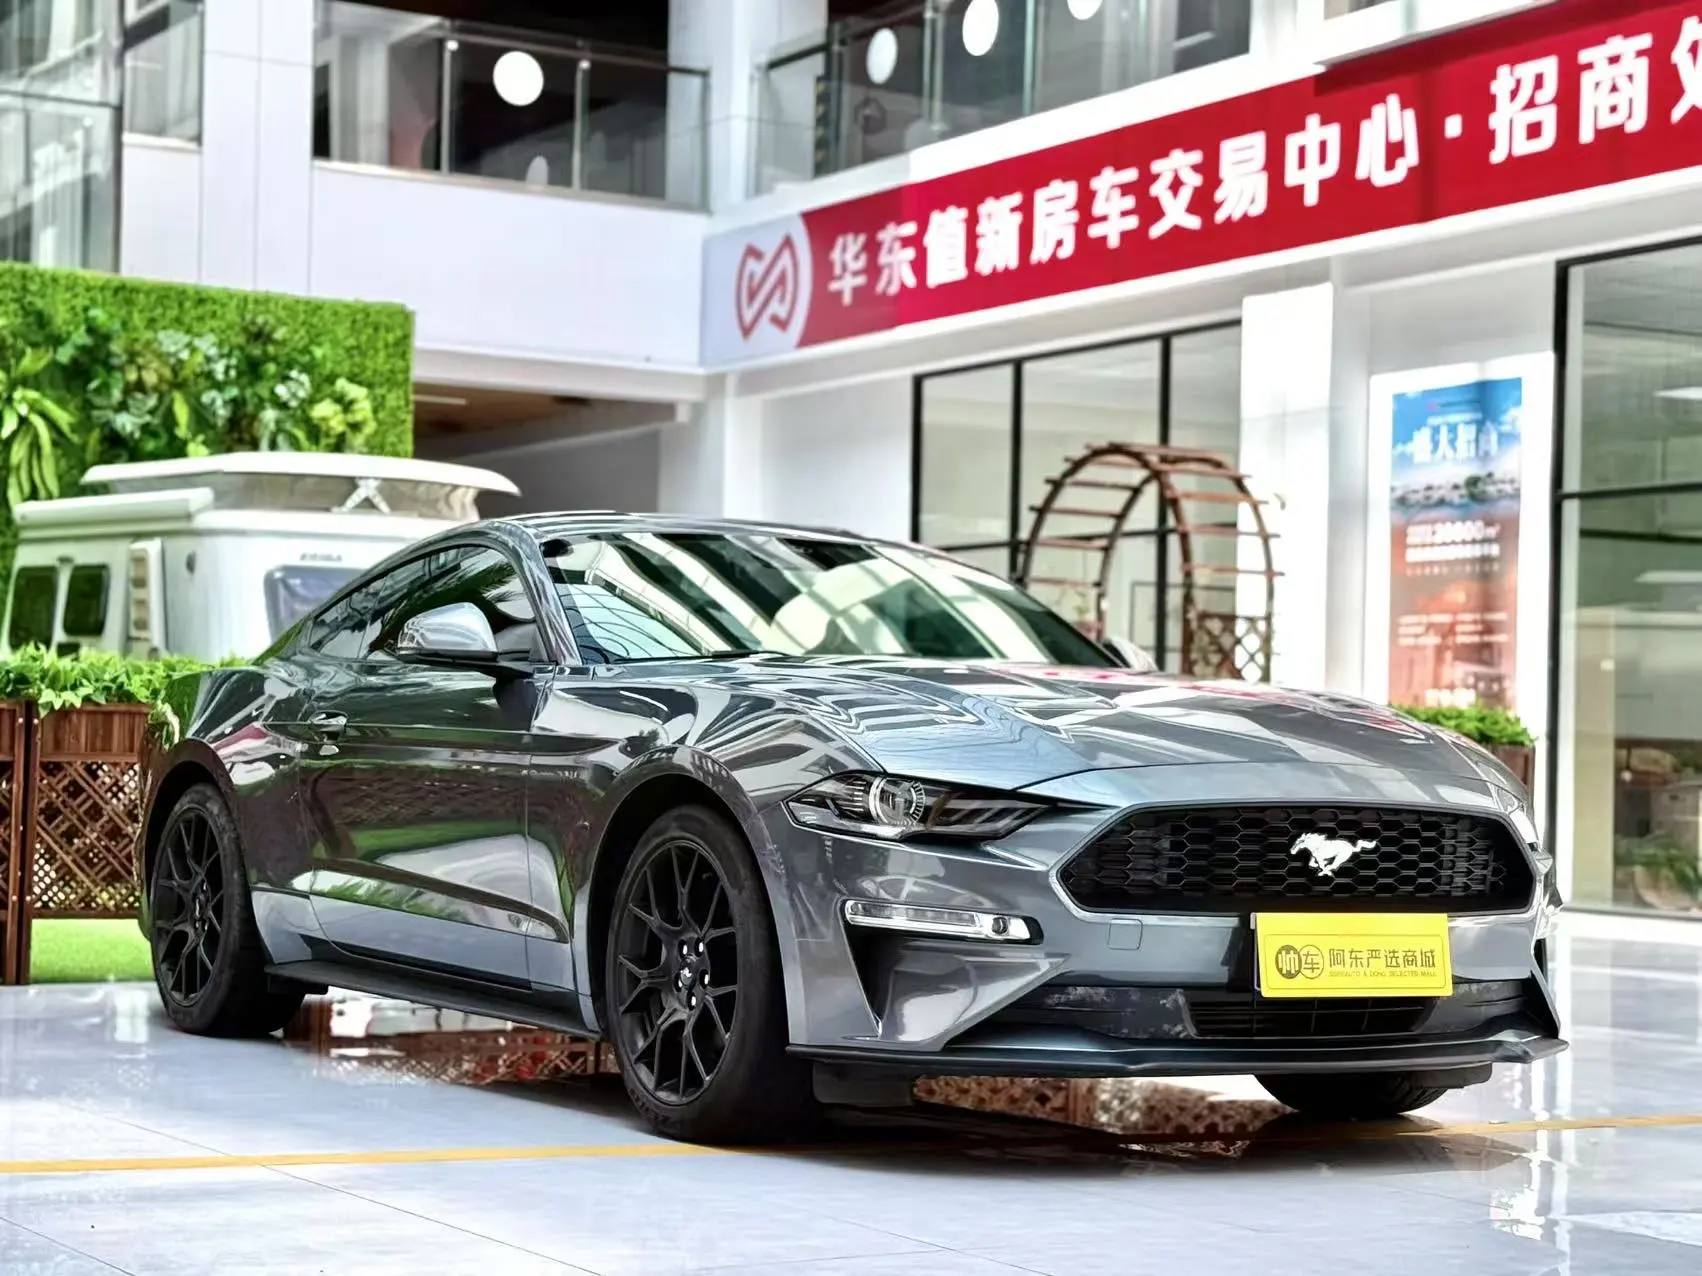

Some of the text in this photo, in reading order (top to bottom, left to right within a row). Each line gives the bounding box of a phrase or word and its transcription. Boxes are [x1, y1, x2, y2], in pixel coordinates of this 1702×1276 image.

[1328, 948, 1436, 968] 阿东严选商城
